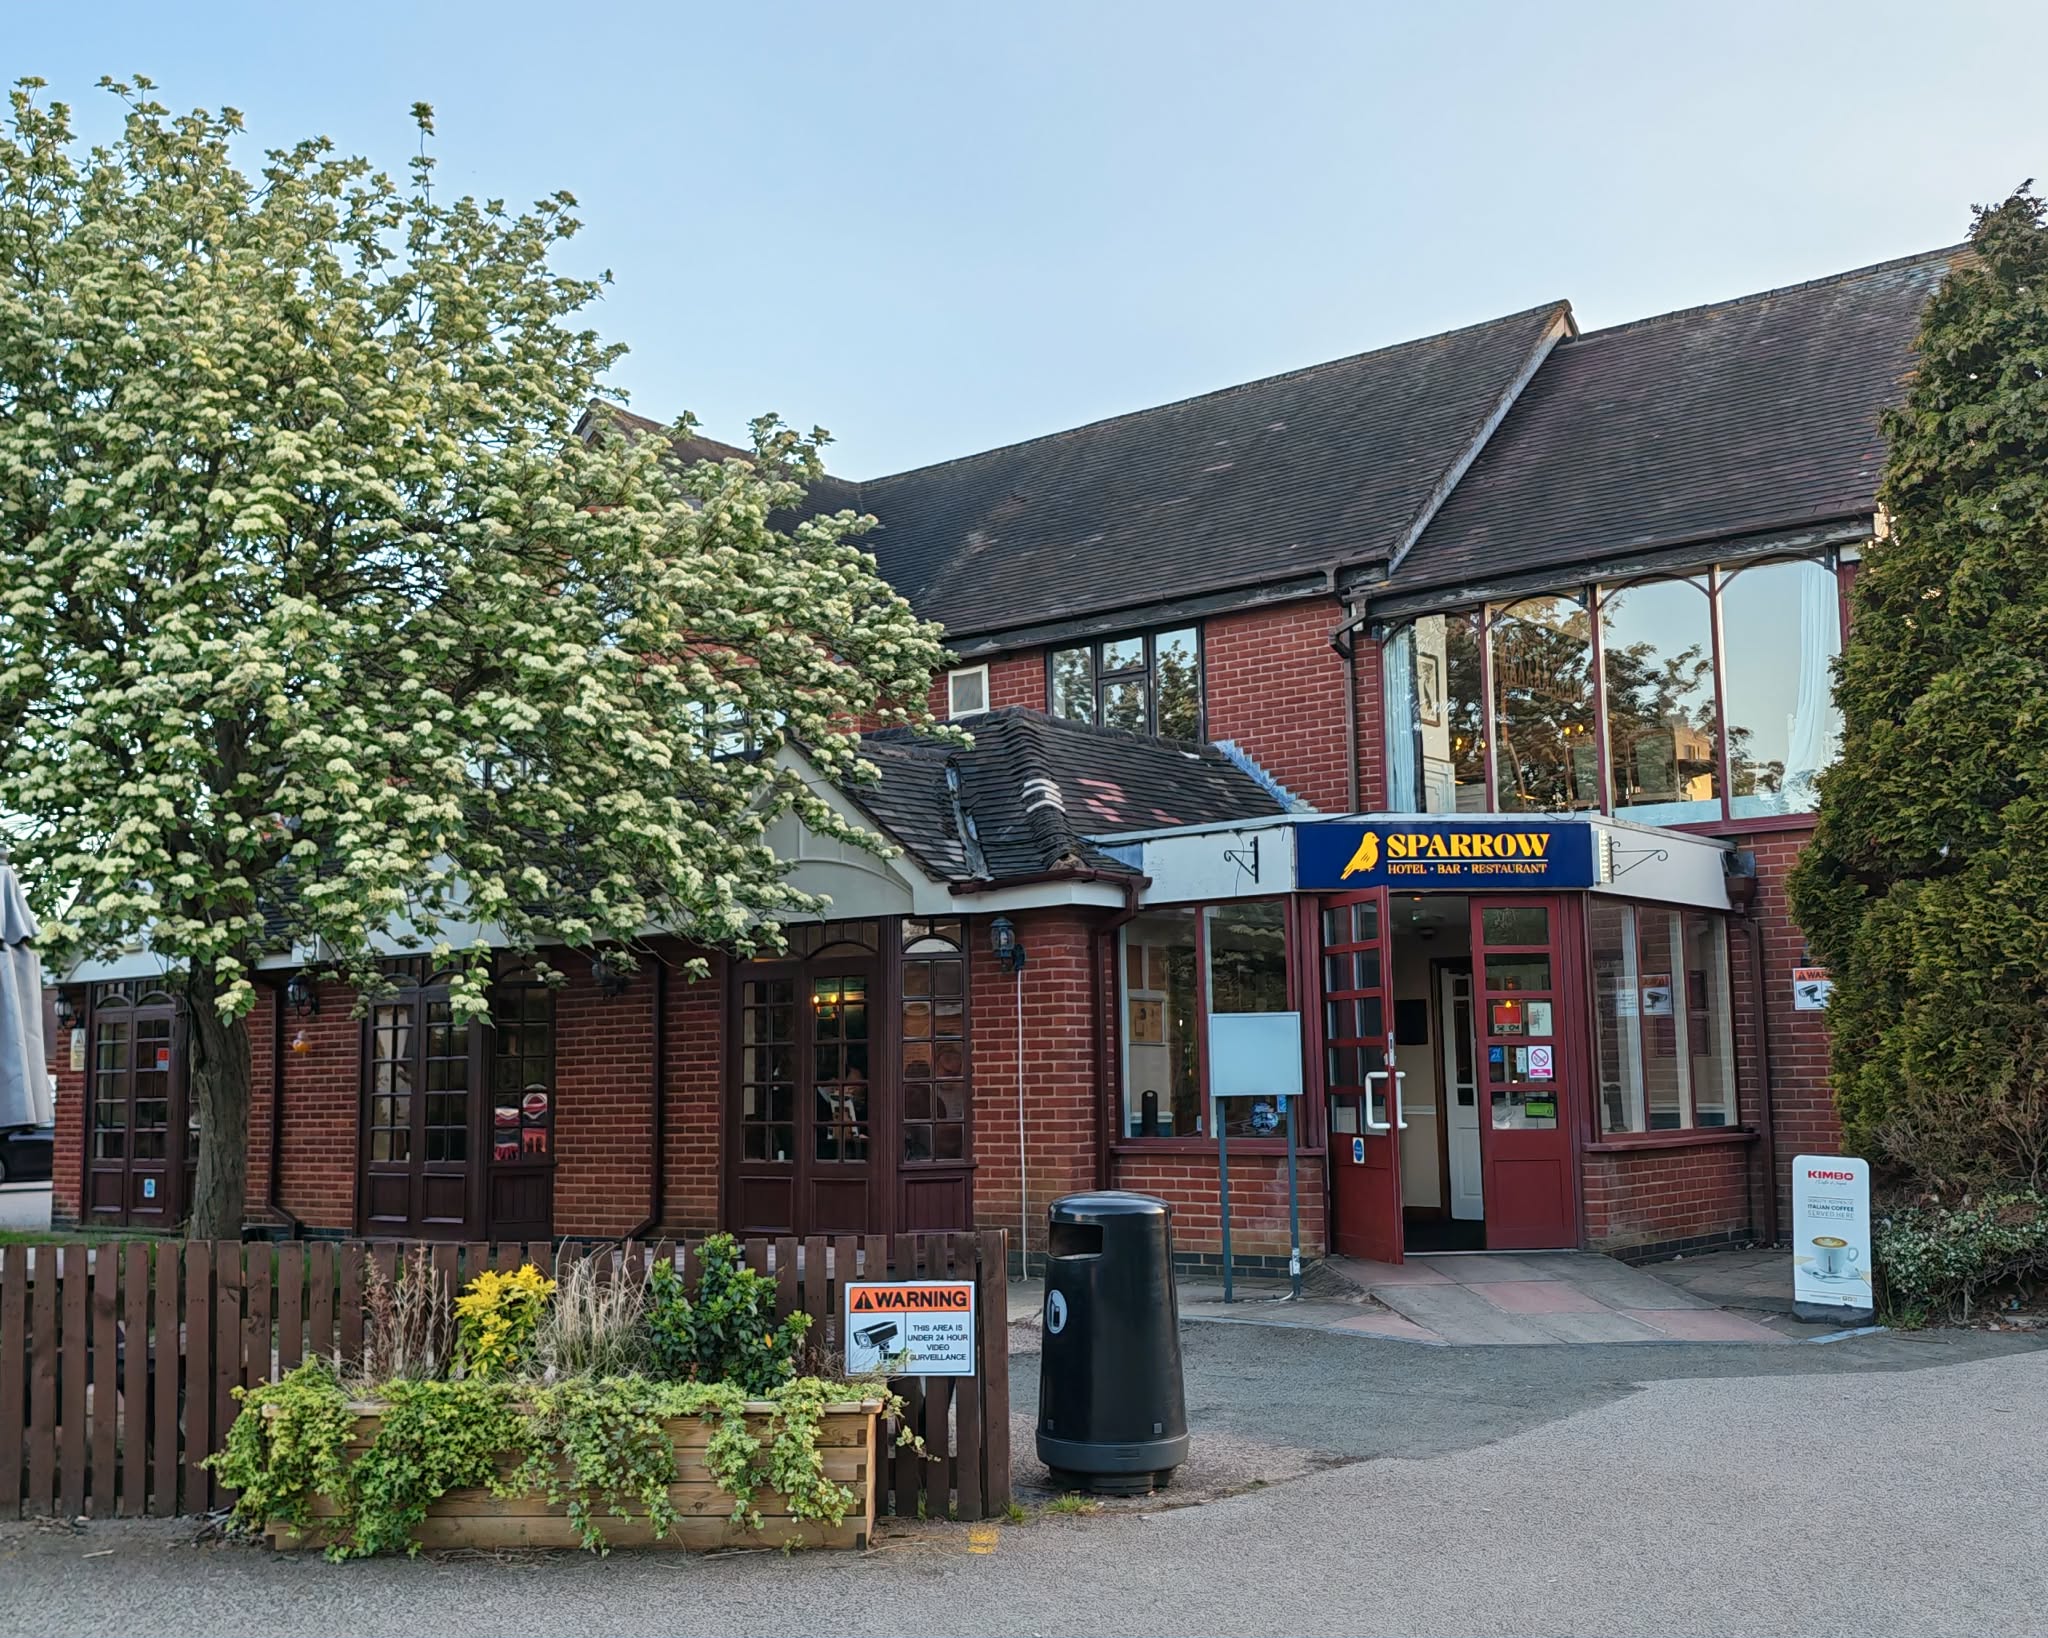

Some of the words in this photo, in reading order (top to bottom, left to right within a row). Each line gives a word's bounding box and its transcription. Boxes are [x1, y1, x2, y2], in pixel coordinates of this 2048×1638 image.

[1387, 833, 1550, 858] SPARROW
[1388, 864, 1427, 874] HOTEL
[1438, 864, 1461, 874] BAR
[1471, 864, 1547, 874] RESTAURANT
[1808, 1170, 1854, 1181] KIMBO
[875, 1291, 967, 1307] WARNING
[947, 1333, 968, 1341] HOUR
[926, 1343, 950, 1351] VIDEO
[910, 1353, 967, 1361] SURVEILLANCE
